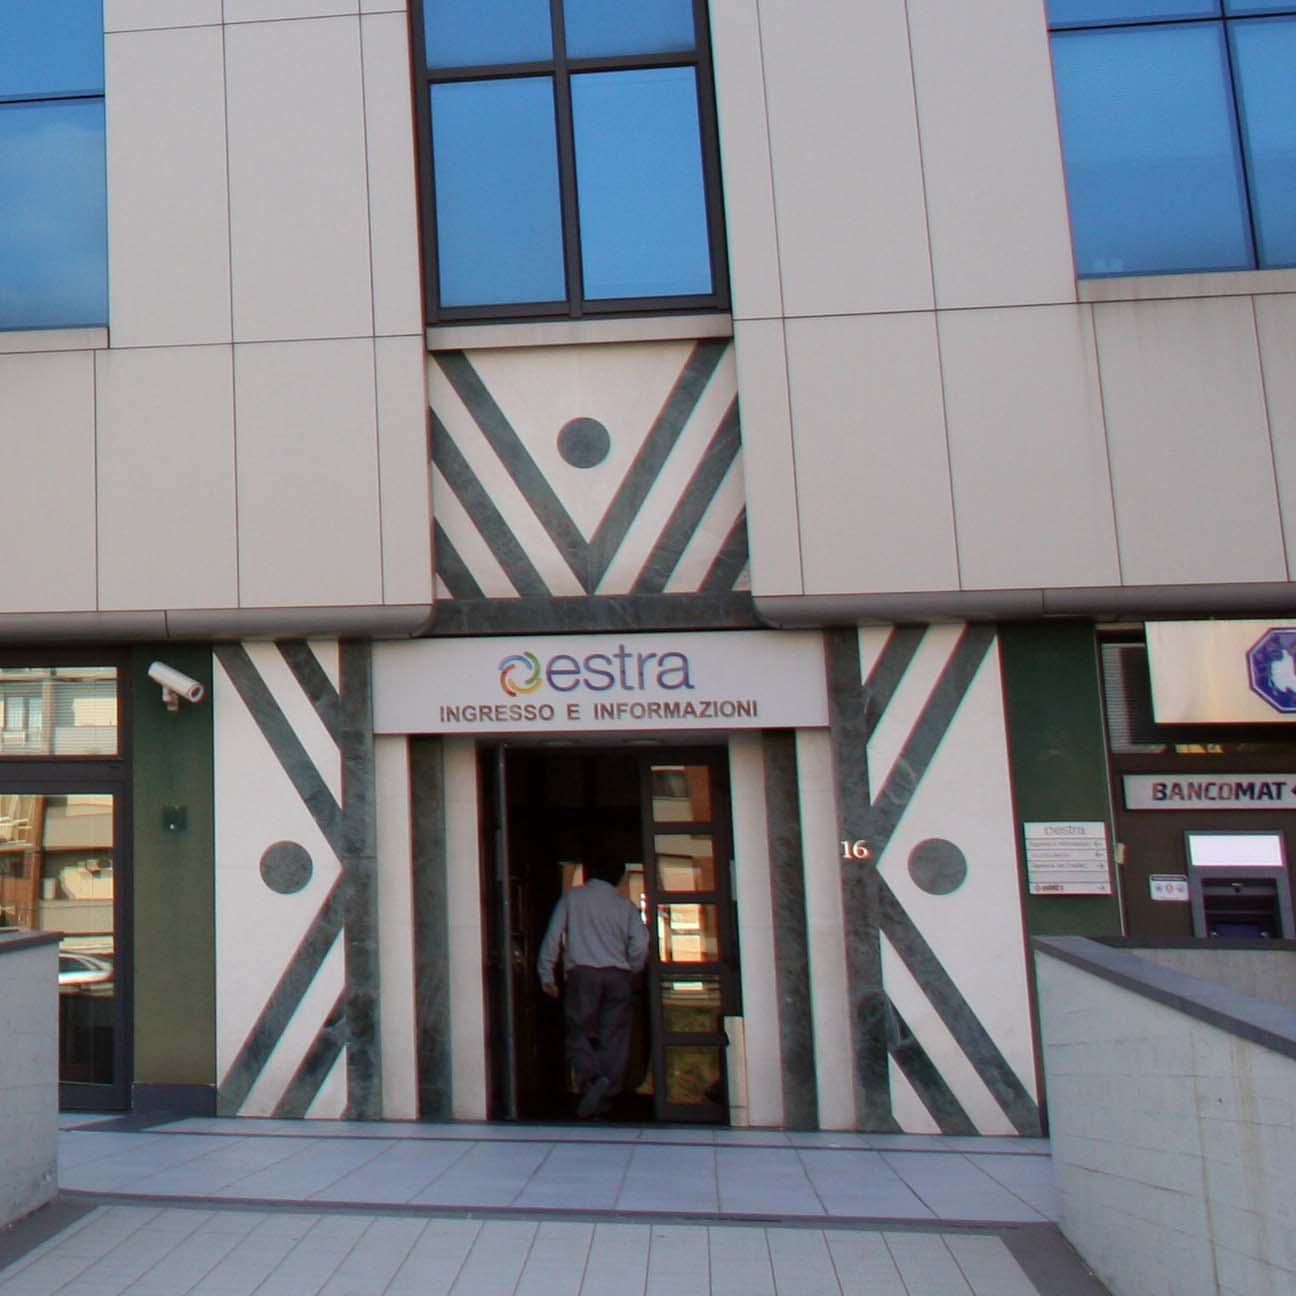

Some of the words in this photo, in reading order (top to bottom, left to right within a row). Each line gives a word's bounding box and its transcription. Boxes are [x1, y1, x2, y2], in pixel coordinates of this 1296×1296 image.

[546, 644, 694, 692] estra
[440, 704, 554, 722] INGRESSO
[566, 703, 580, 720] E
[594, 700, 757, 720] INFORMAZIONI
[1152, 782, 1287, 801] BANCOMAT
[840, 839, 869, 859] 16
